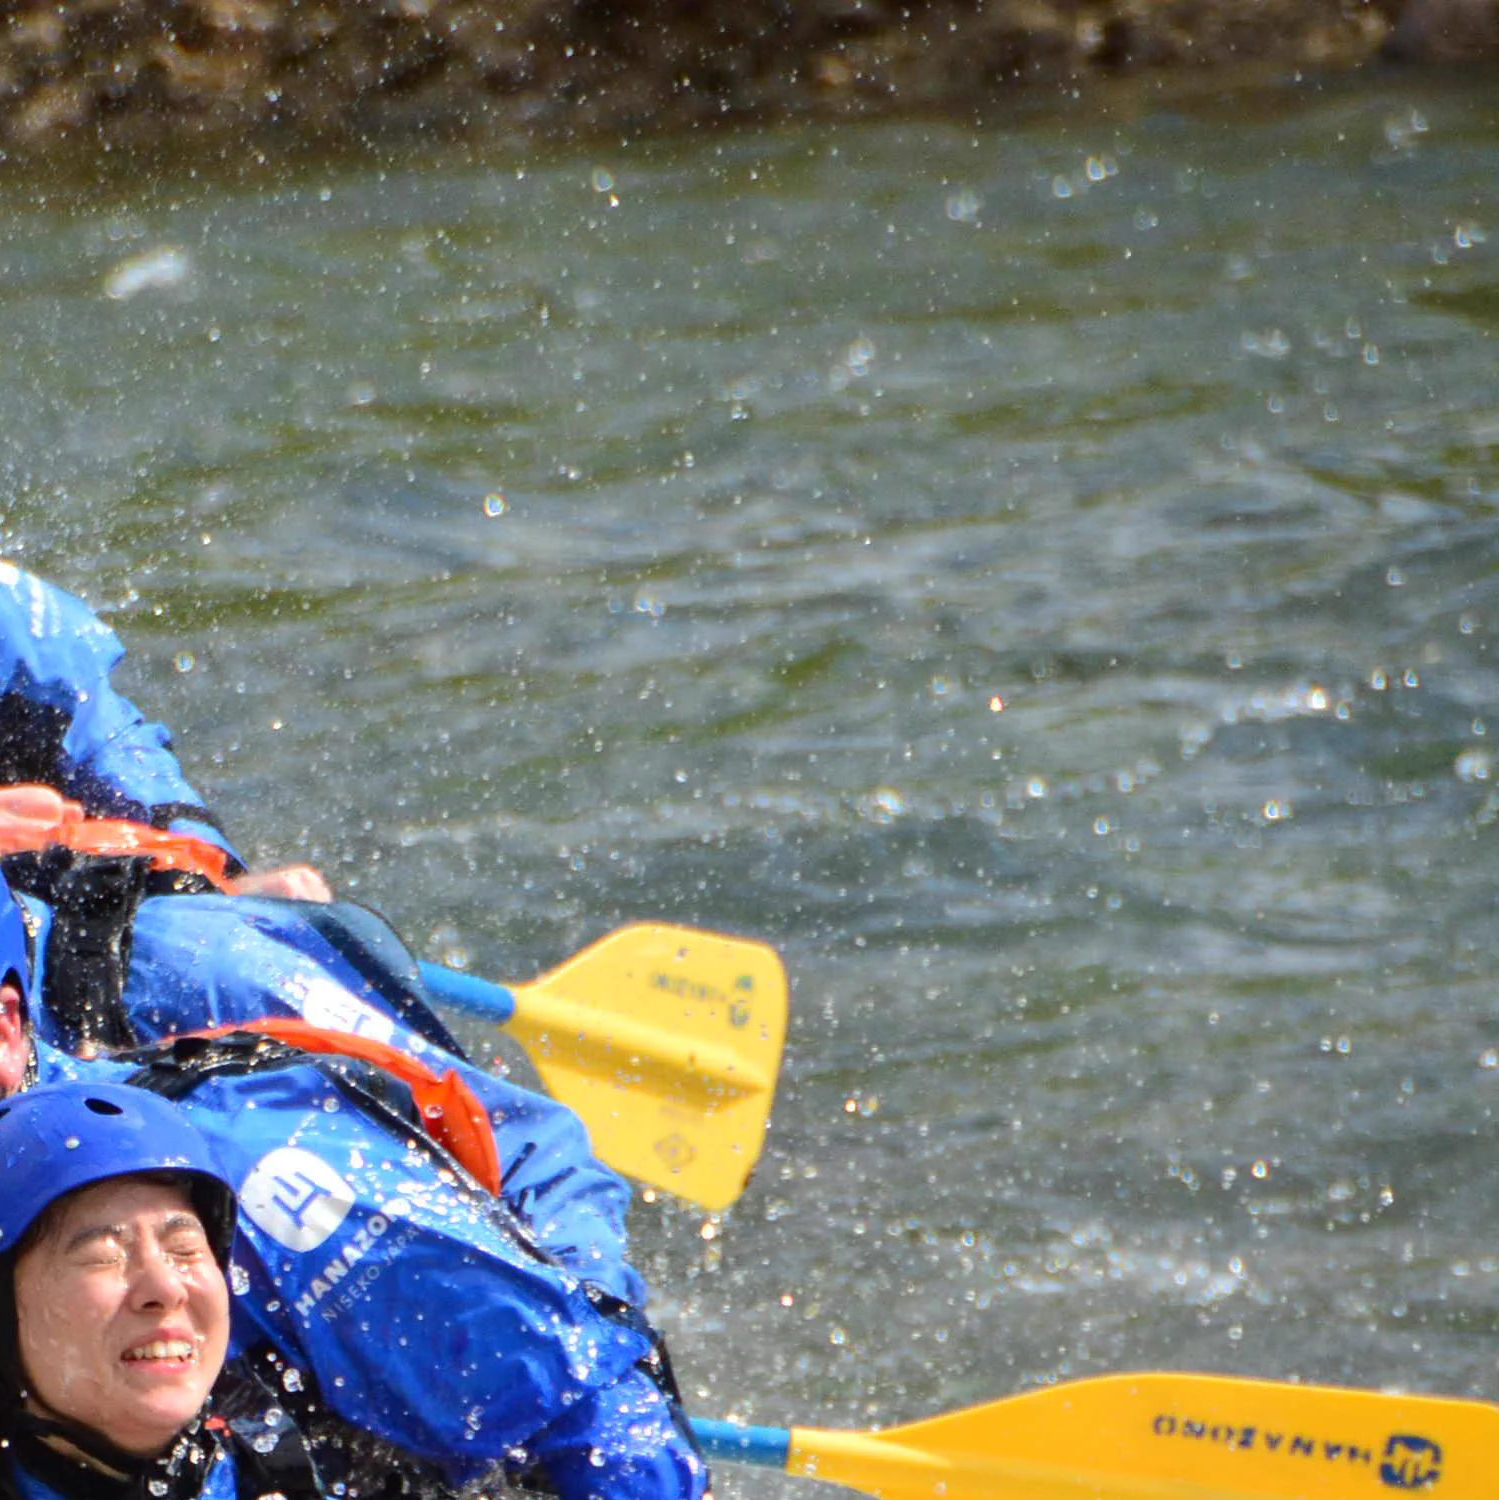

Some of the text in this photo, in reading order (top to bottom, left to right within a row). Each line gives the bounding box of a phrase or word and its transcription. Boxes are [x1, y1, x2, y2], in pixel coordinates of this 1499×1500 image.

[294, 1208, 393, 1317] HANAZO
[321, 1265, 381, 1323] NISEKO
[1152, 1414, 1372, 1465] HANAZONO
